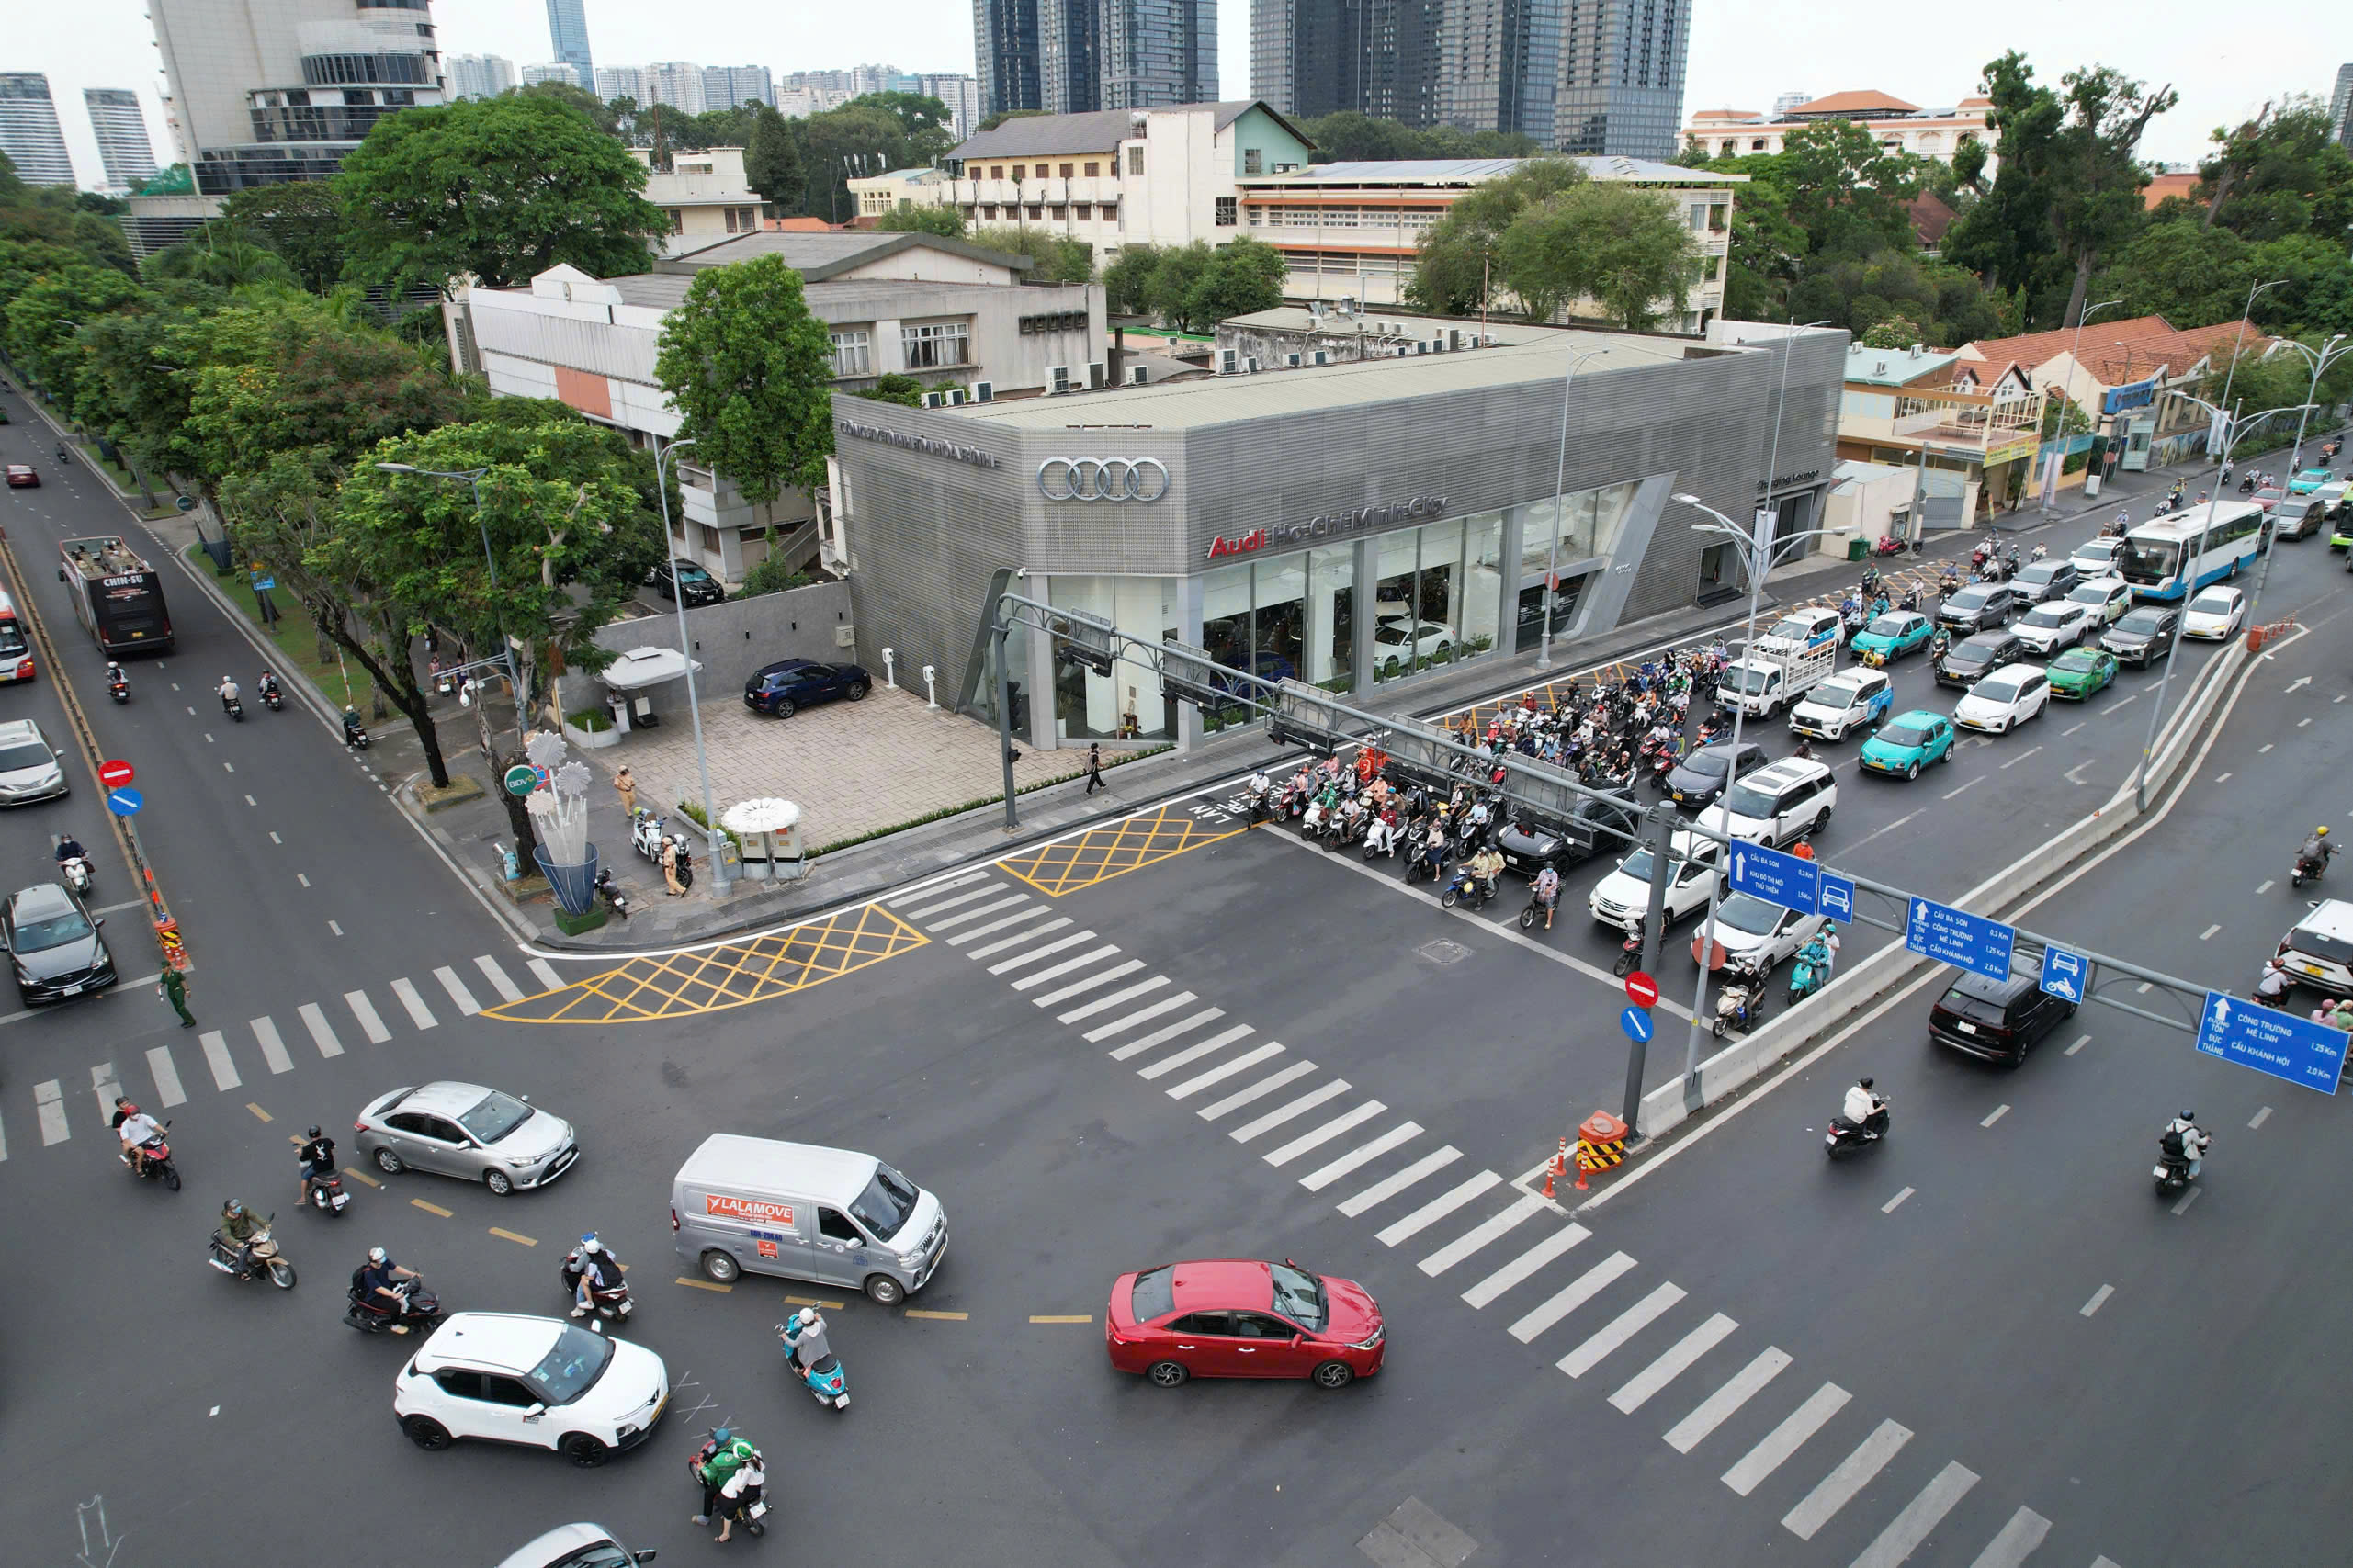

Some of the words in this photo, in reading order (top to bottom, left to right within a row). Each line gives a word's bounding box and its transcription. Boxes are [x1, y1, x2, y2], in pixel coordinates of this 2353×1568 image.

[1793, 470, 1819, 482] Lounge
[1207, 528, 1266, 558] Audi
[1271, 524, 1302, 545] Ho
[1310, 513, 1345, 536] Chi
[1352, 504, 1404, 530] Minh
[1409, 496, 1448, 518] City
[103, 574, 144, 587] CHIN-SU
[509, 778, 527, 788] BIDV
[1769, 859, 1779, 868] SON
[1934, 911, 1944, 919] CẦU
[1956, 918, 1968, 927] SON
[1933, 923, 1948, 933] CÔNG
[1998, 931, 2008, 940] Km
[1949, 939, 1963, 948] LINH
[1930, 944, 1942, 953] CẦU
[1942, 948, 1963, 961] KHÁNH
[1996, 948, 2006, 957] Km
[1993, 965, 2003, 974] Km
[2238, 1013, 2259, 1027] CÔNG
[2246, 1027, 2258, 1038] MÊ
[2259, 1031, 2278, 1043] LINH
[2231, 1041, 2246, 1053] CẦU
[2247, 1044, 2275, 1062] KHÁNH
[2276, 1053, 2290, 1066] HỘI
[2311, 1042, 2324, 1053] 1.25
[2324, 1046, 2337, 1057] Km
[2306, 1066, 2317, 1076] 2.0
[2317, 1068, 2331, 1079] Km
[721, 1198, 792, 1218] LALAMOVE
